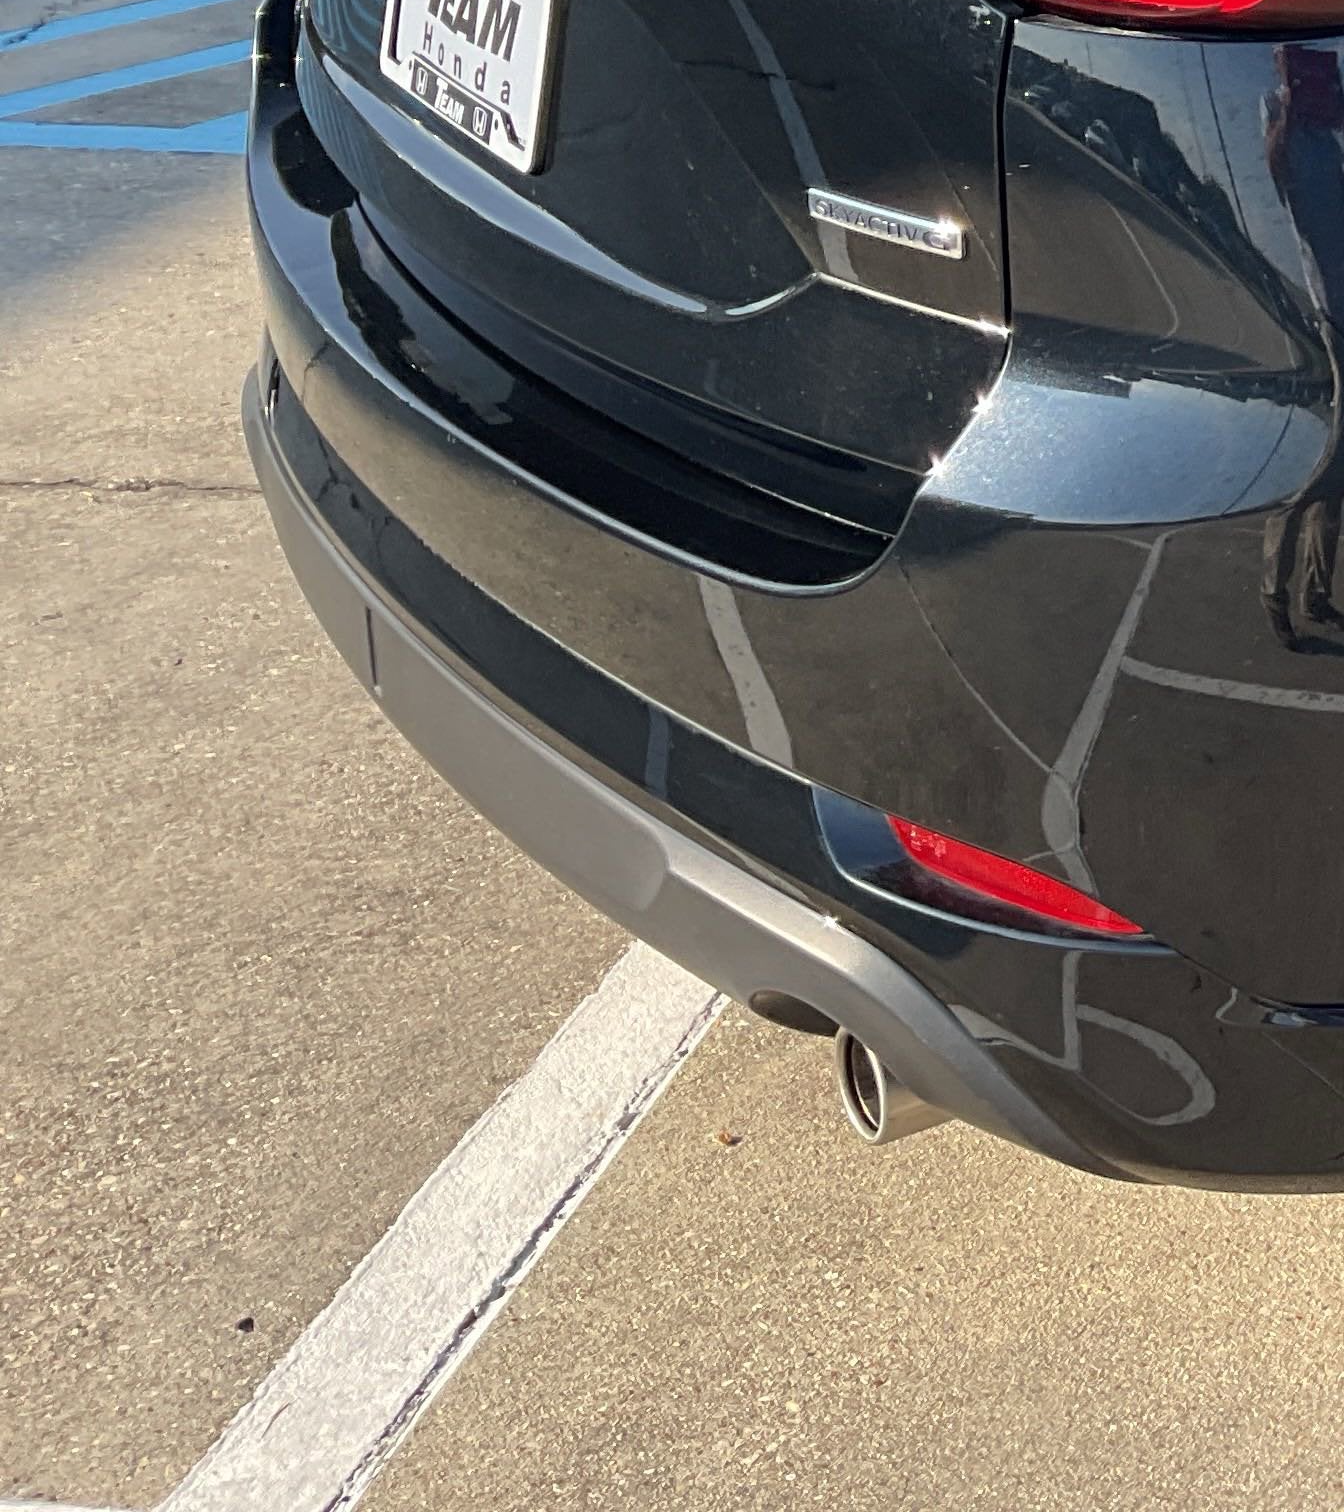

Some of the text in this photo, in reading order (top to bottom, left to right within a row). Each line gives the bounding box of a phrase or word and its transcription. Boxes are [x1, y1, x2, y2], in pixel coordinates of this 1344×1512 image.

[422, 20, 512, 106] Honda
[434, 76, 466, 126] TEAM
[814, 198, 920, 241] SKYACTIV
